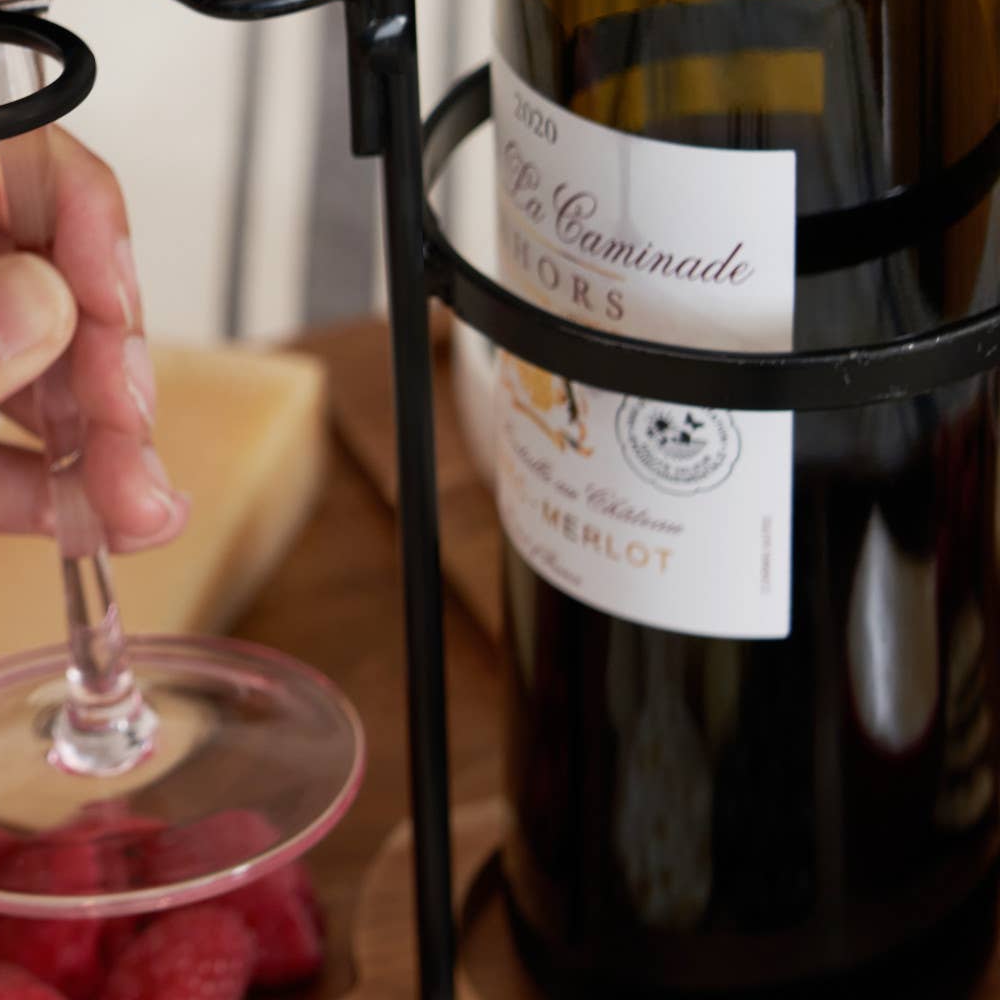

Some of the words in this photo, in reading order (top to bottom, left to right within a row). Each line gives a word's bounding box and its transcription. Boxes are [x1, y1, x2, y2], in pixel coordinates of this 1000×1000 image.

[513, 92, 558, 145] 2020
[503, 140, 546, 225] La
[552, 182, 754, 286] Caminade
